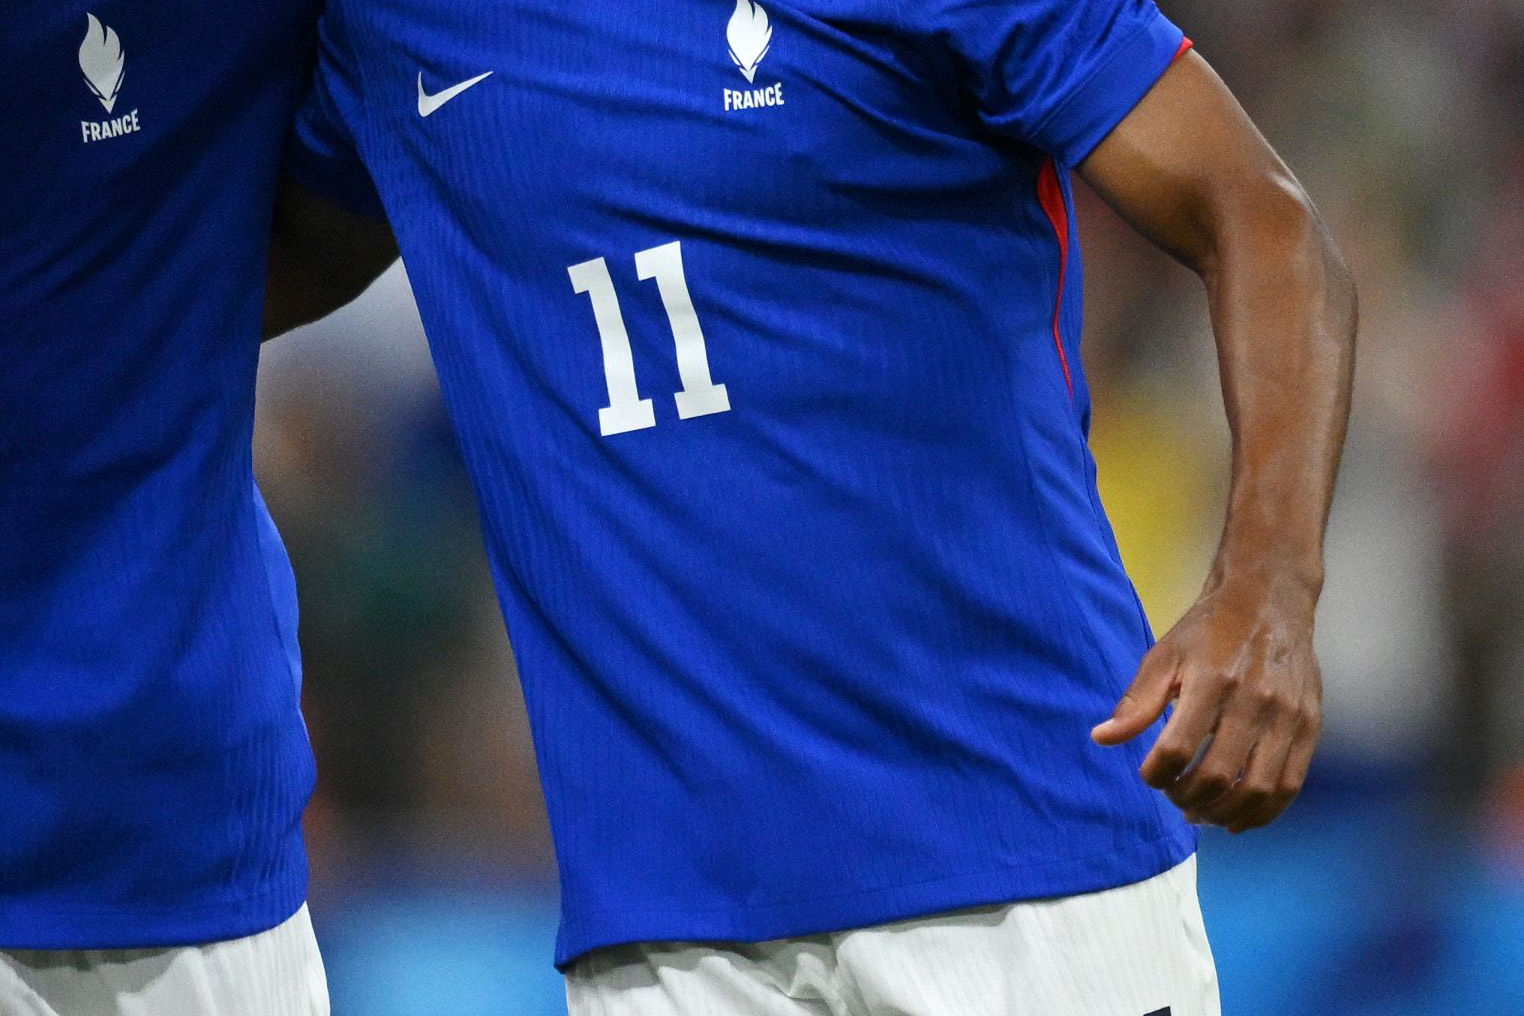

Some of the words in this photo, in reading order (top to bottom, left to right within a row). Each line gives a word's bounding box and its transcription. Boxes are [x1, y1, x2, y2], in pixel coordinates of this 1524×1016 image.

[724, 83, 784, 111] FRANCE
[82, 108, 140, 142] FRANCE
[567, 241, 731, 436] 11
